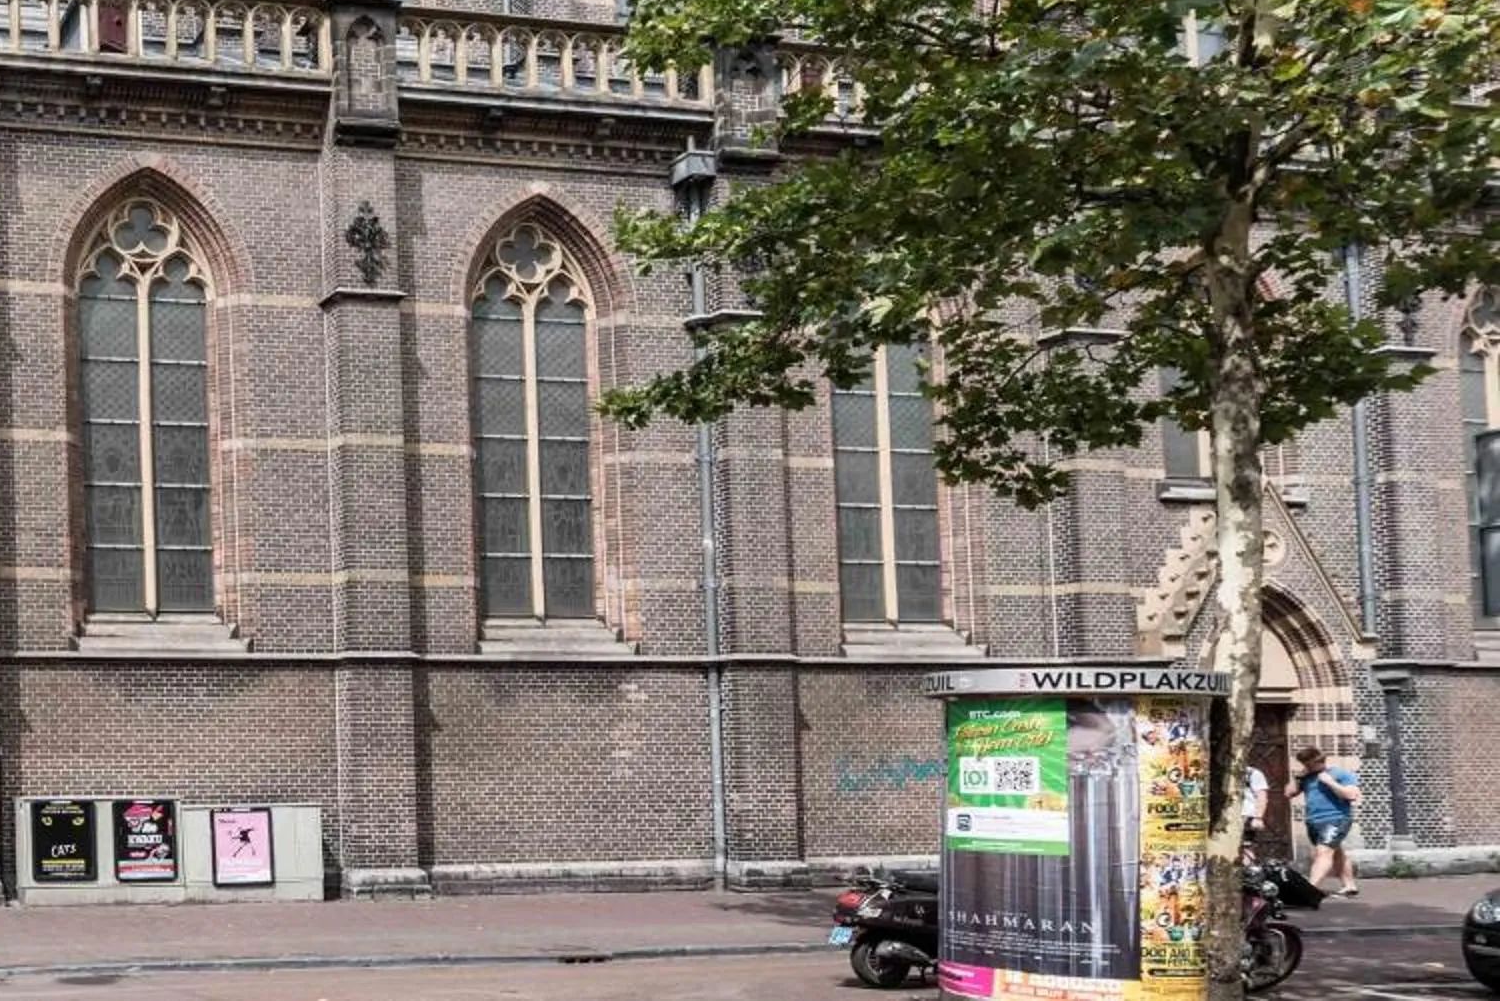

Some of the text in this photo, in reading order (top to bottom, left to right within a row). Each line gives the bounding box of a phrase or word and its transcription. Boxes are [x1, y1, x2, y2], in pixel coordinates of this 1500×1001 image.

[1031, 671, 1228, 691] WILDPLAKZUIL
[51, 843, 77, 858] CATS
[948, 910, 1097, 934] SHAHMARAN
